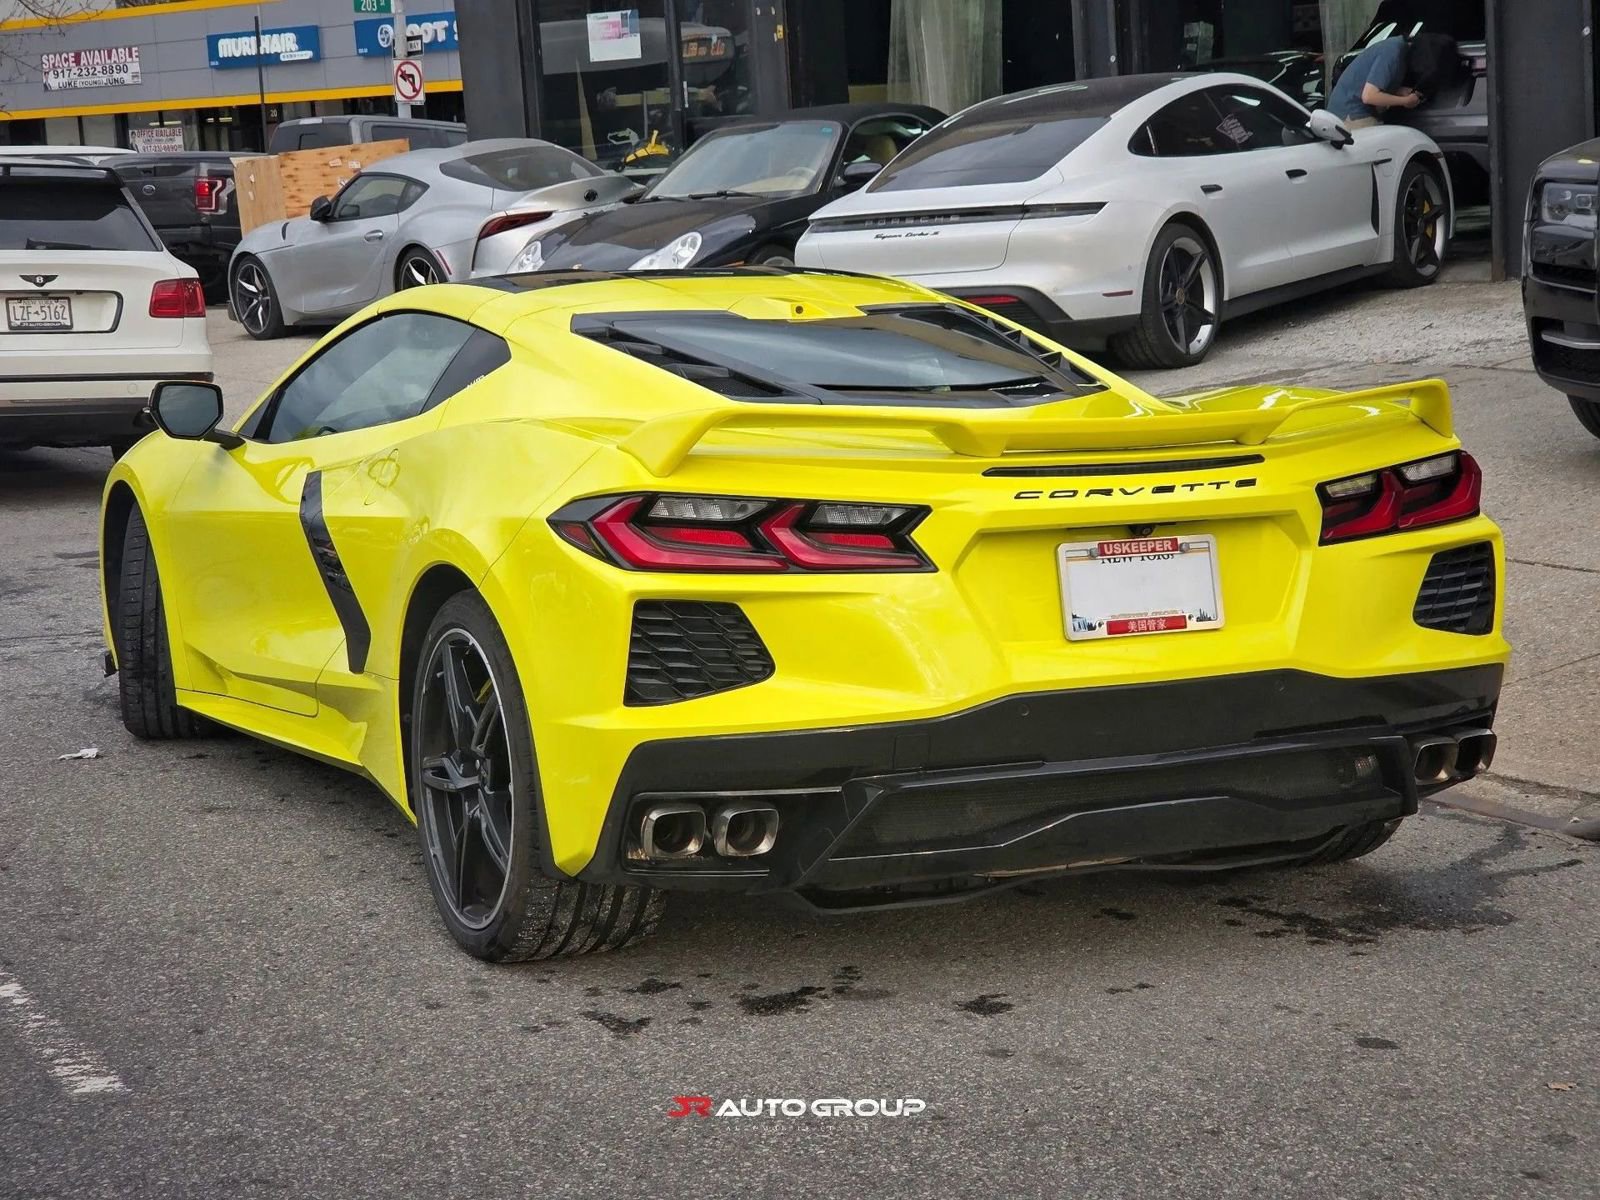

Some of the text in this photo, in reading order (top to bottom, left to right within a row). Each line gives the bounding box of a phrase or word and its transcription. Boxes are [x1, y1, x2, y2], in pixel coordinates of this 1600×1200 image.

[361, 0, 377, 11] 203
[405, 20, 449, 44] OOT
[42, 47, 139, 69] SPACE AVAILABLE
[53, 64, 129, 79] 917-232-8890
[58, 80, 78, 89] LUKE
[104, 77, 125, 85] JUNG
[1014, 478, 1257, 500] CORVETTE
[1103, 539, 1173, 555] USKEEPER
[1127, 618, 1167, 632] 美国管家
